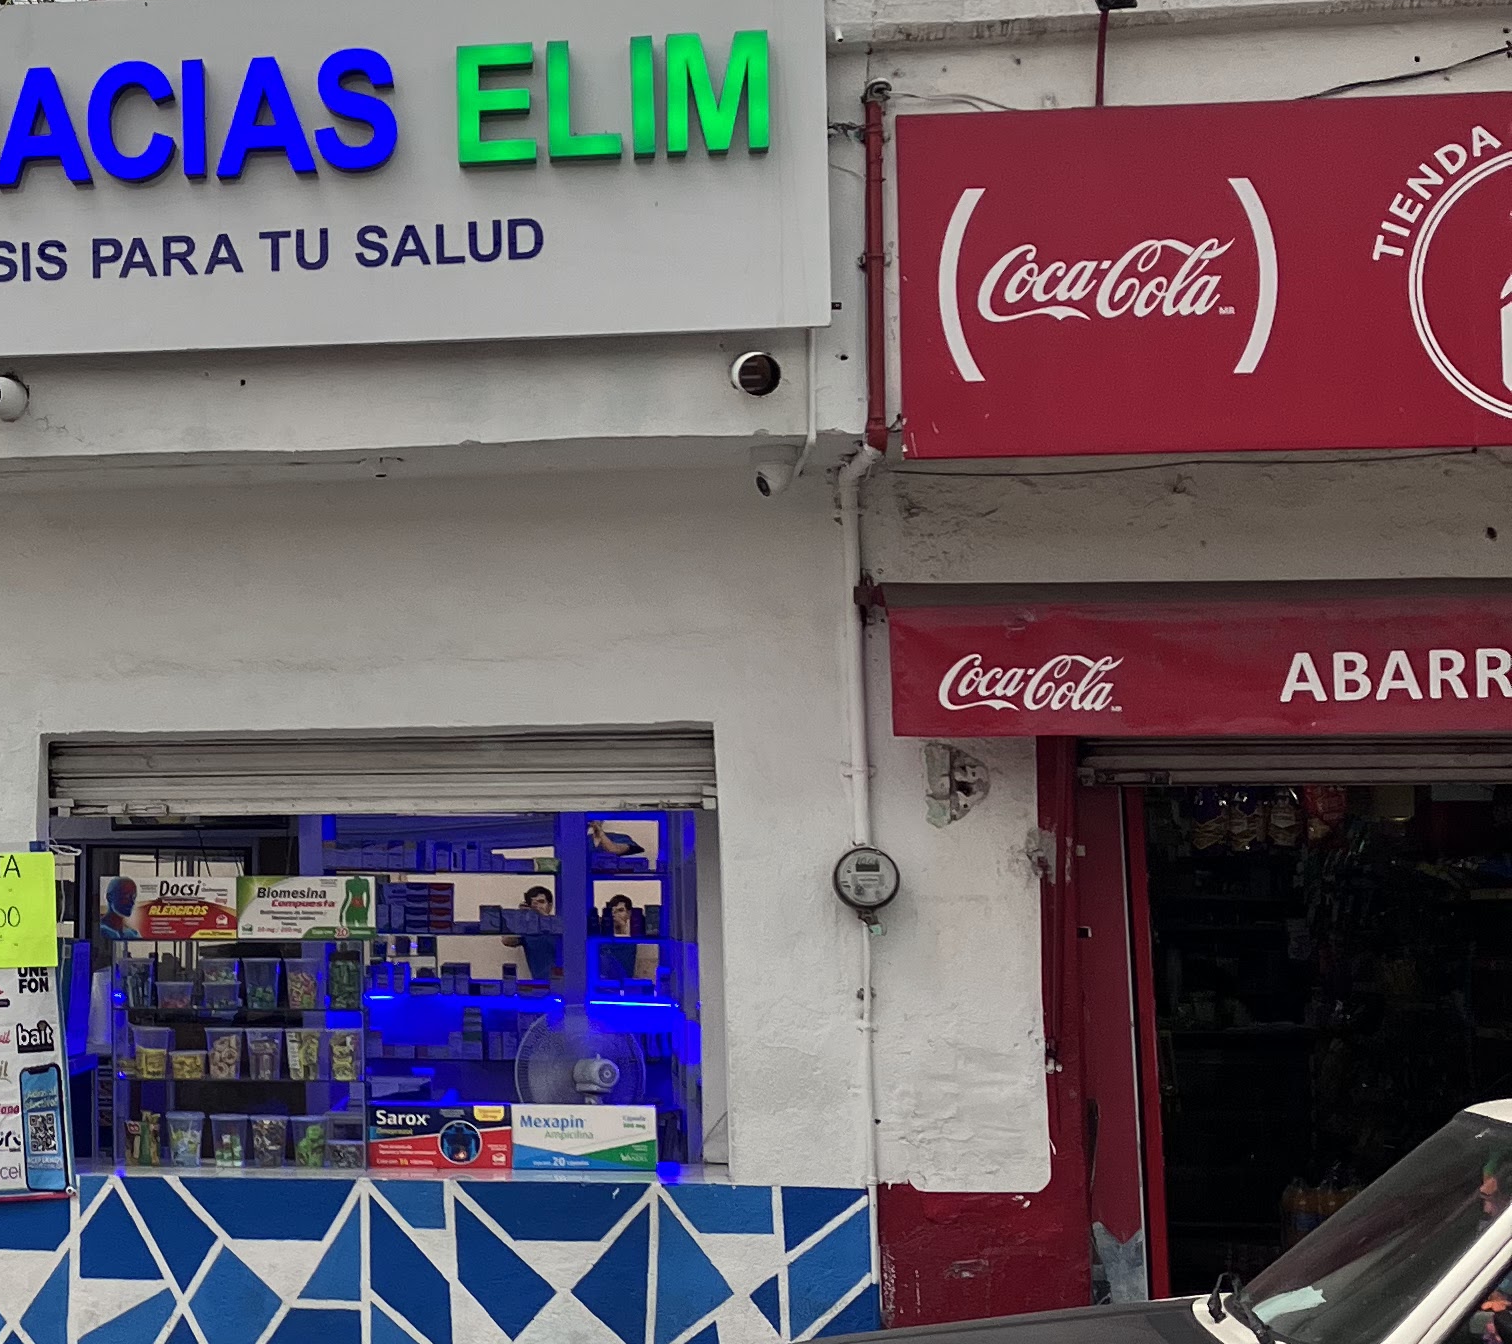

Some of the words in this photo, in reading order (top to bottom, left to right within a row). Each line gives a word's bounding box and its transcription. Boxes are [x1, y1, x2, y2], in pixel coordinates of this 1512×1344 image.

[456, 30, 771, 168] ELIM
[1372, 125, 1502, 261] TIENDA
[91, 232, 243, 279] PARA
[259, 226, 330, 273] TU
[354, 217, 545, 268] SALUD
[977, 237, 1235, 323] Coca-Cola
[938, 653, 1125, 712] Coca-Cola
[1280, 648, 1512, 703] ABARR
[159, 880, 202, 897] Docsi
[257, 887, 327, 899] Biomesina
[19, 977, 50, 994] FON
[375, 1109, 428, 1126] Sarox
[520, 1115, 584, 1131] Mexapin
[545, 1129, 594, 1140] Ampicilina
[552, 1156, 566, 1167] 20
